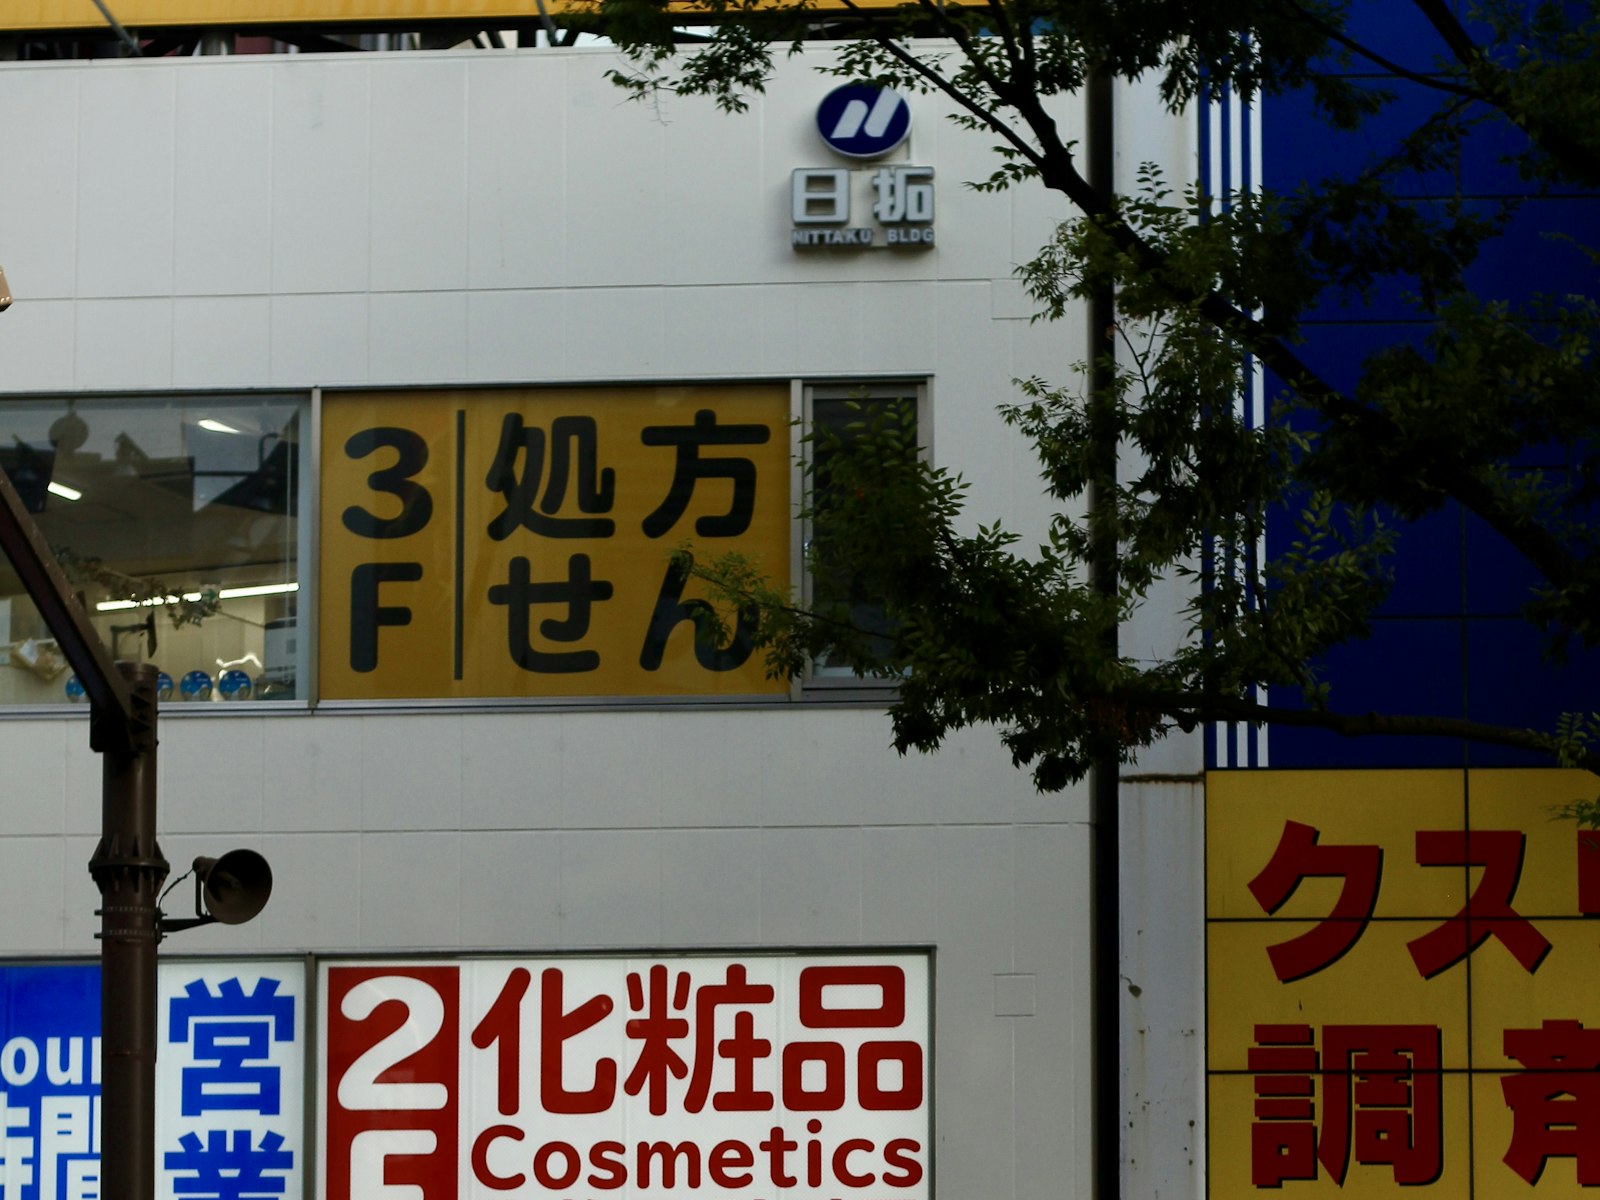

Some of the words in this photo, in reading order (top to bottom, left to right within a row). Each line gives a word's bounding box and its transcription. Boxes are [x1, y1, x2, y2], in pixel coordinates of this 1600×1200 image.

[792, 166, 935, 225] 日拓
[792, 228, 873, 247] NITTAKU
[886, 227, 935, 246] BLDG
[487, 409, 771, 542] 処方
[487, 550, 765, 674] せん
[471, 964, 923, 1116] 化粧品
[471, 1119, 923, 1190] Cosmetics
